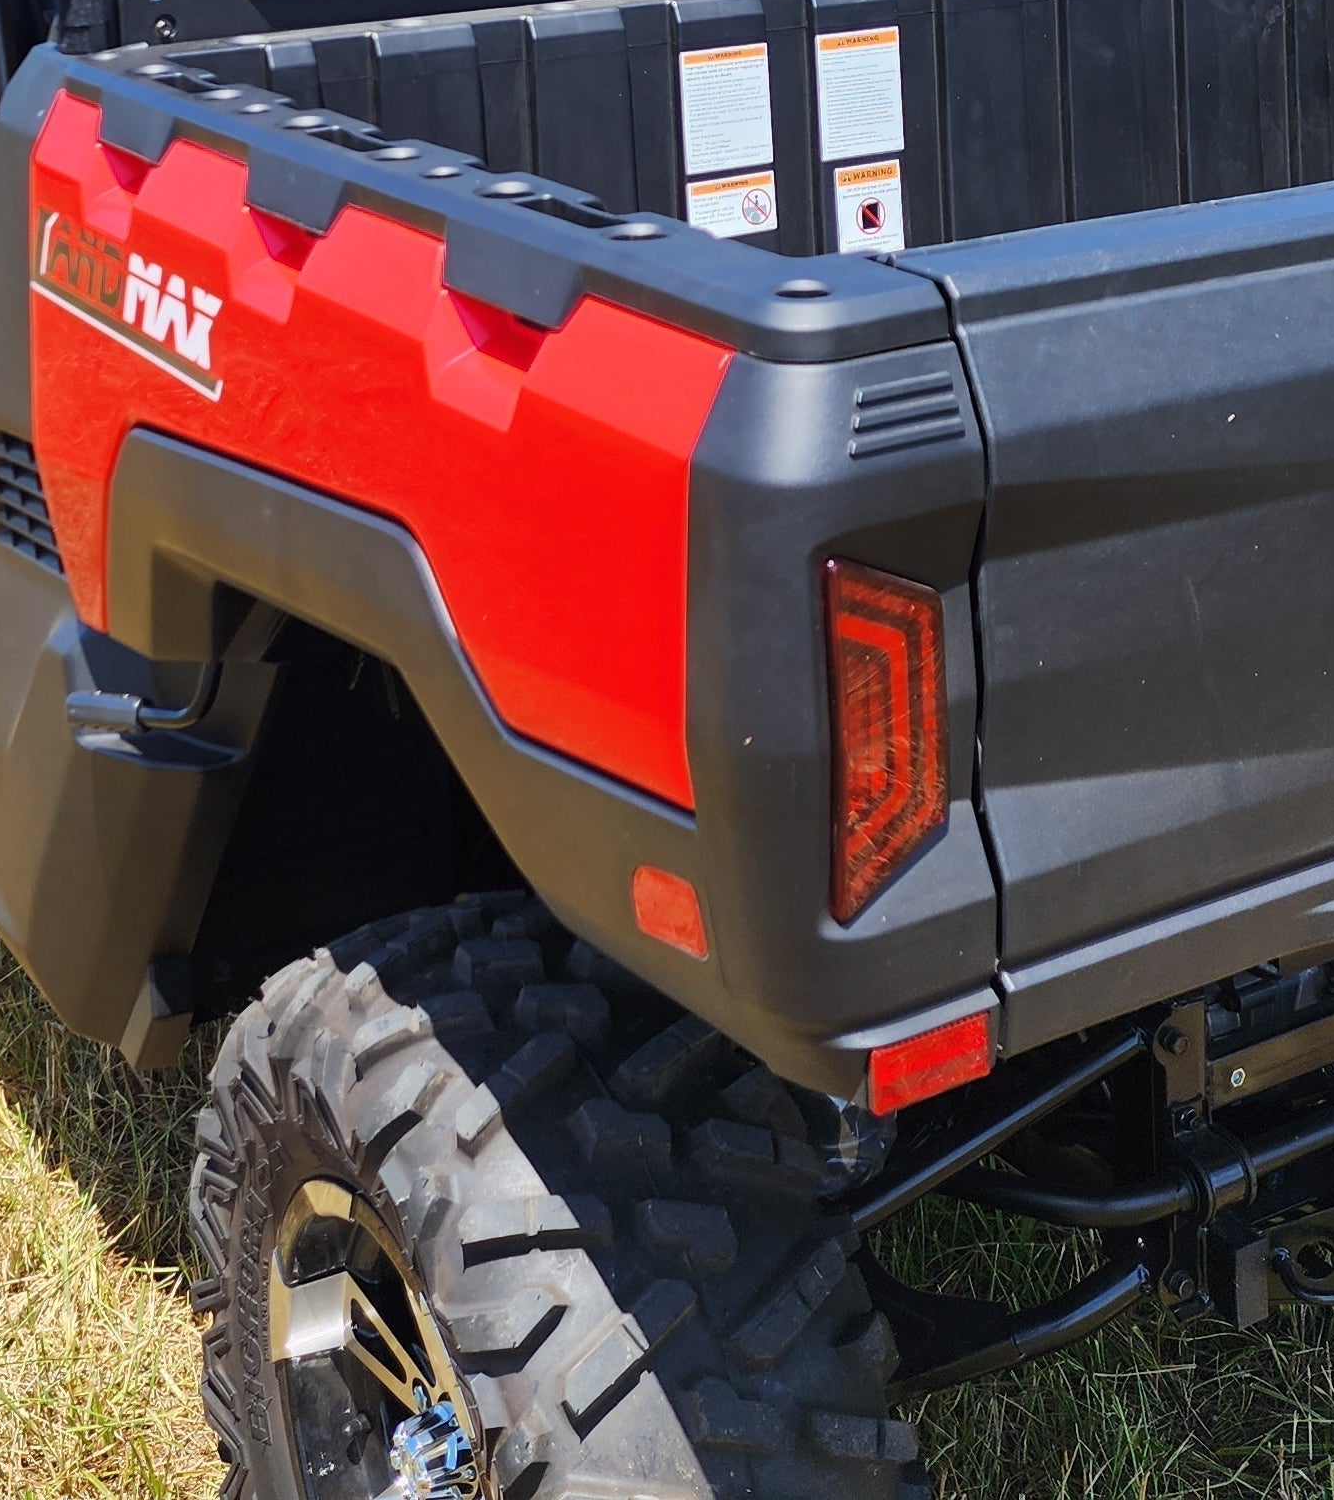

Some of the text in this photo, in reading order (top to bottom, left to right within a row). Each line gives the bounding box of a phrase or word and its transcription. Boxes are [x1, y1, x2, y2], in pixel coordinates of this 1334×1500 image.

[846, 34, 880, 45] WARNING
[852, 167, 893, 180] WARNING
[30, 205, 224, 402] LANDMAX
